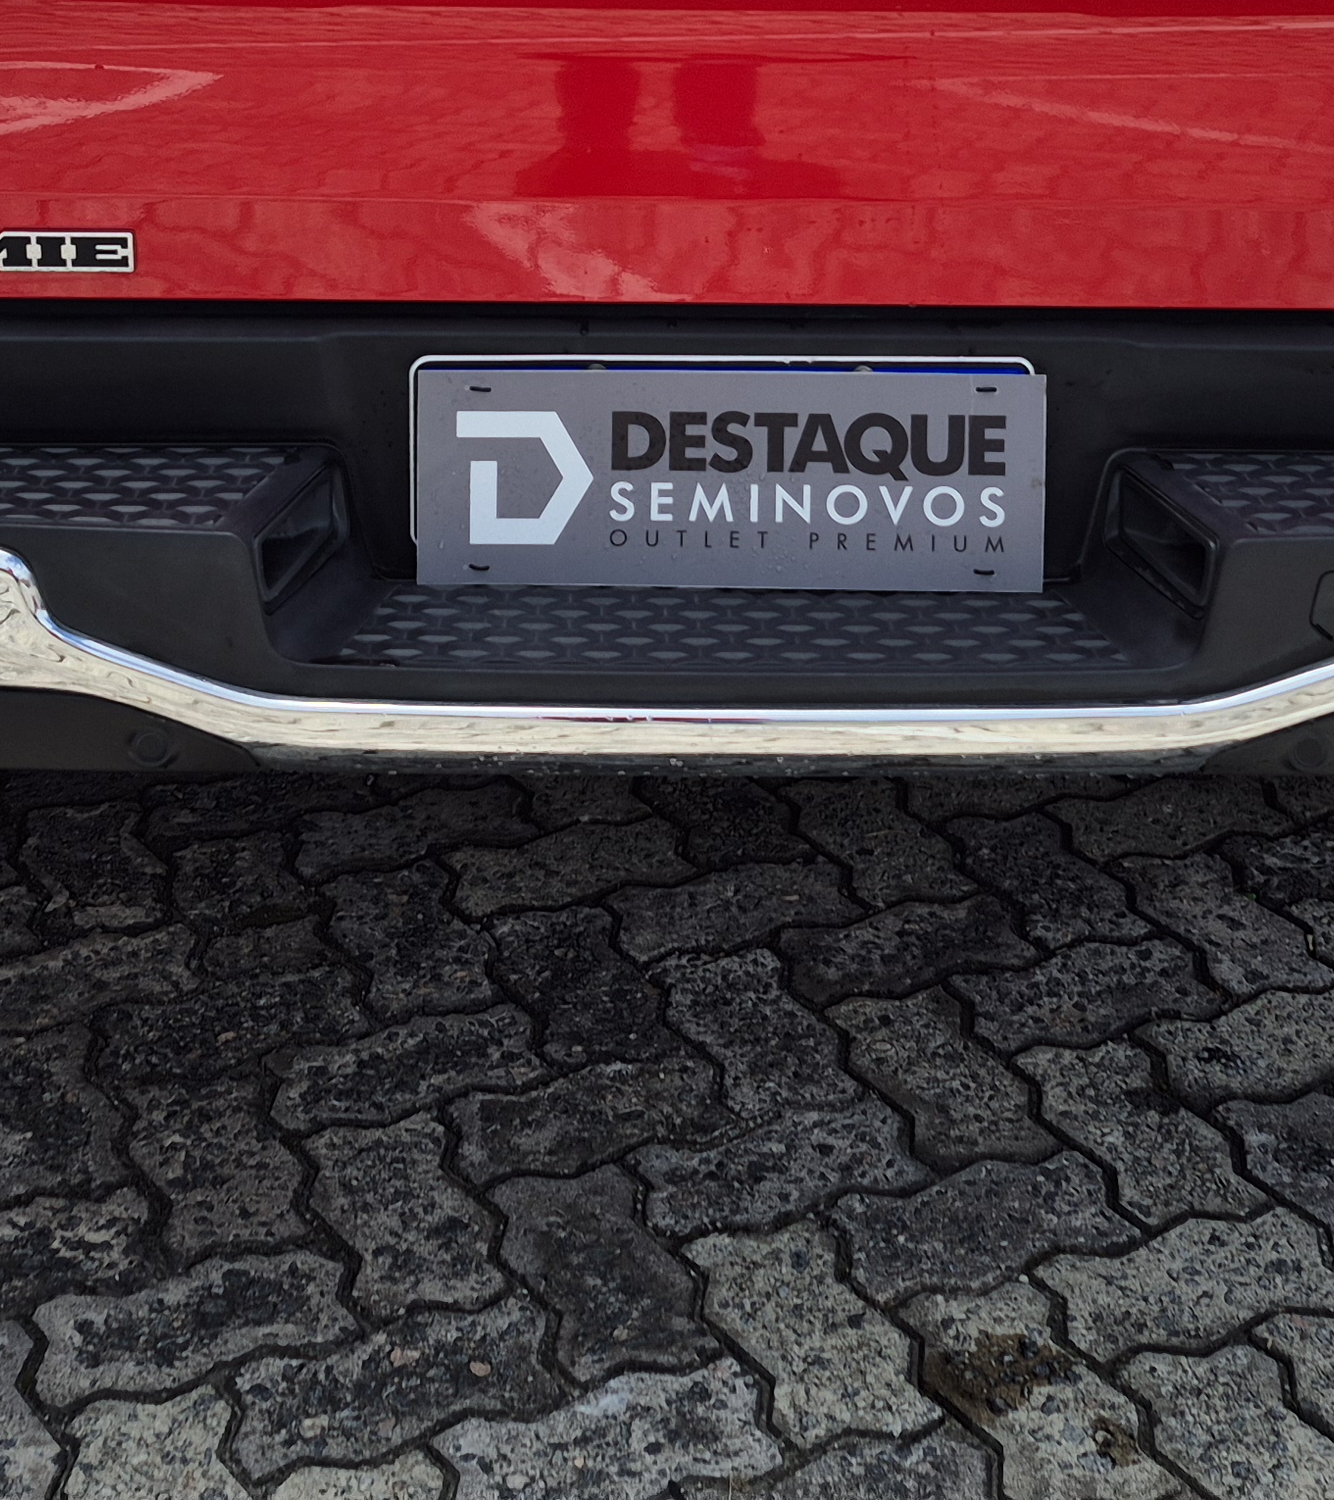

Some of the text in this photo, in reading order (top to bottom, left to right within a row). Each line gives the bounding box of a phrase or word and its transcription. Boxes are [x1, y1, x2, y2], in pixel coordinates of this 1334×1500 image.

[610, 410, 1007, 481] DESTAQUE
[608, 481, 1007, 528] SEMINOVOS
[609, 529, 1006, 554] OUTLET PREMIUM
